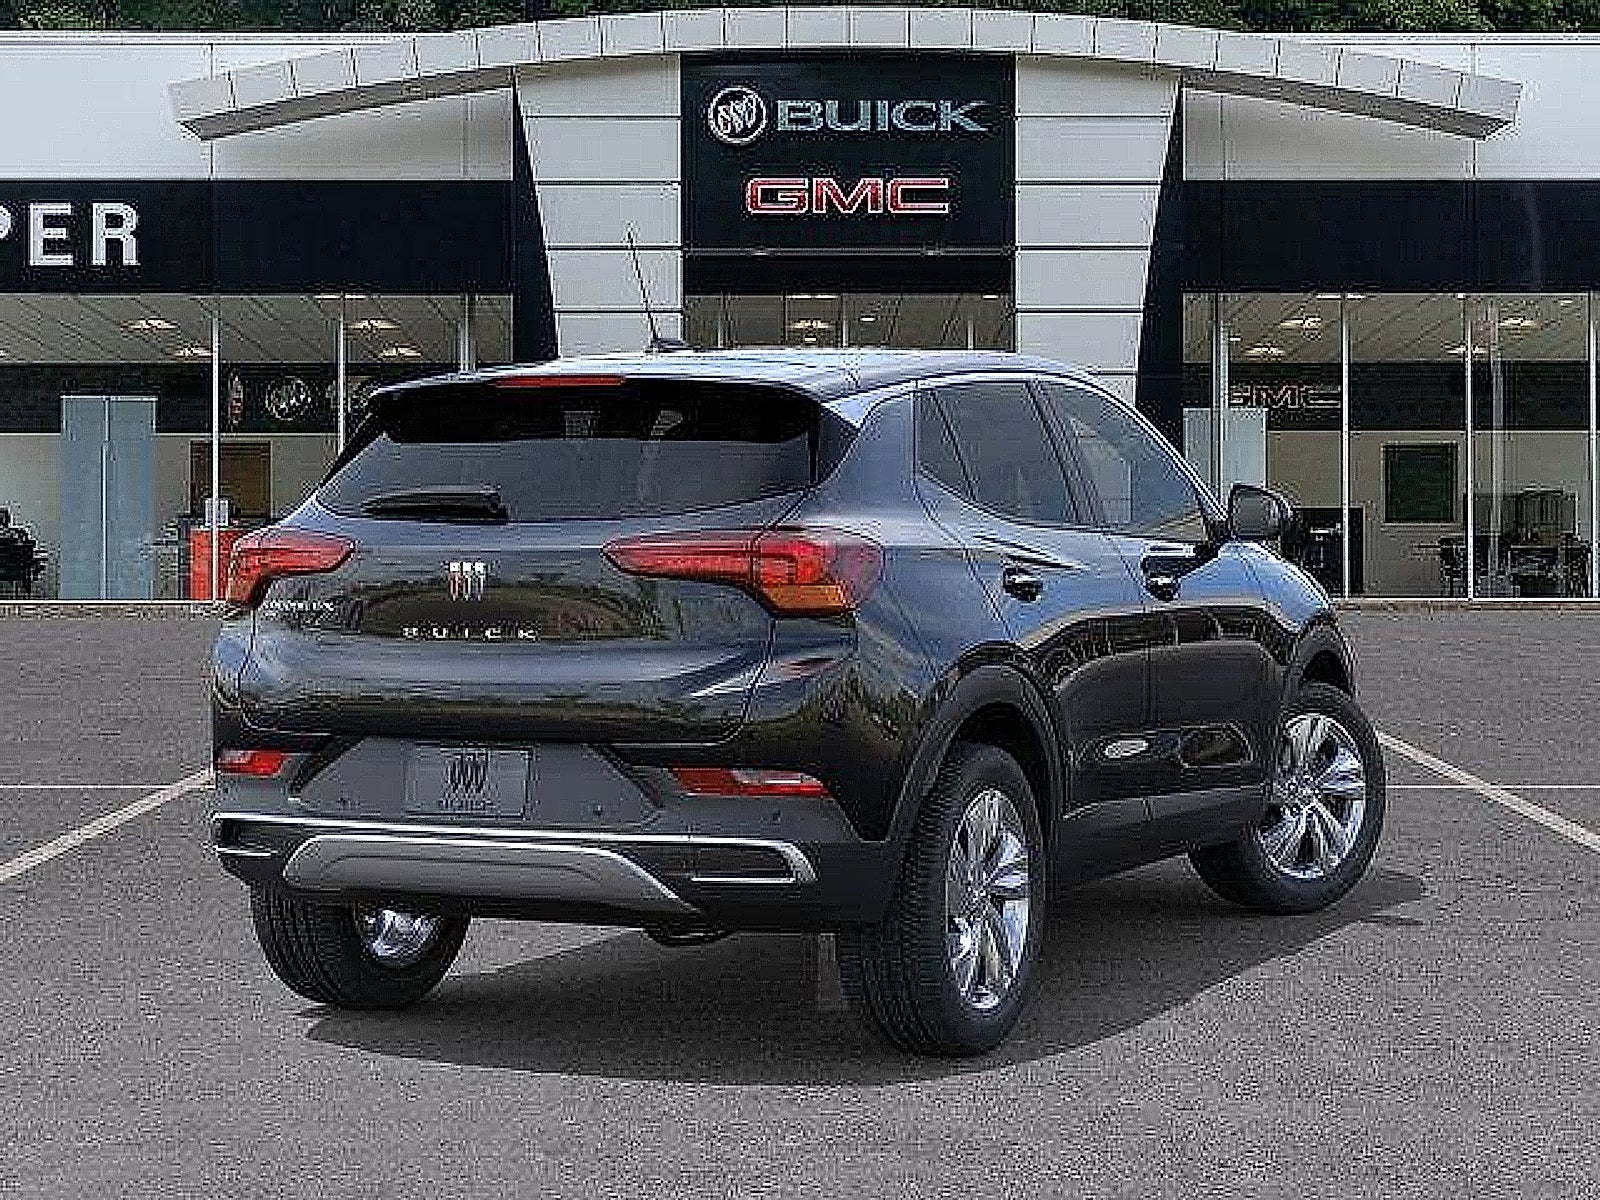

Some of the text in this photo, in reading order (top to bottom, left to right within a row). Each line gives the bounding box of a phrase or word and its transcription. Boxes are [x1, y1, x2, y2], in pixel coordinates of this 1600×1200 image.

[777, 99, 989, 132] BUICK
[745, 176, 950, 215] GMC
[0, 202, 141, 267] ER
